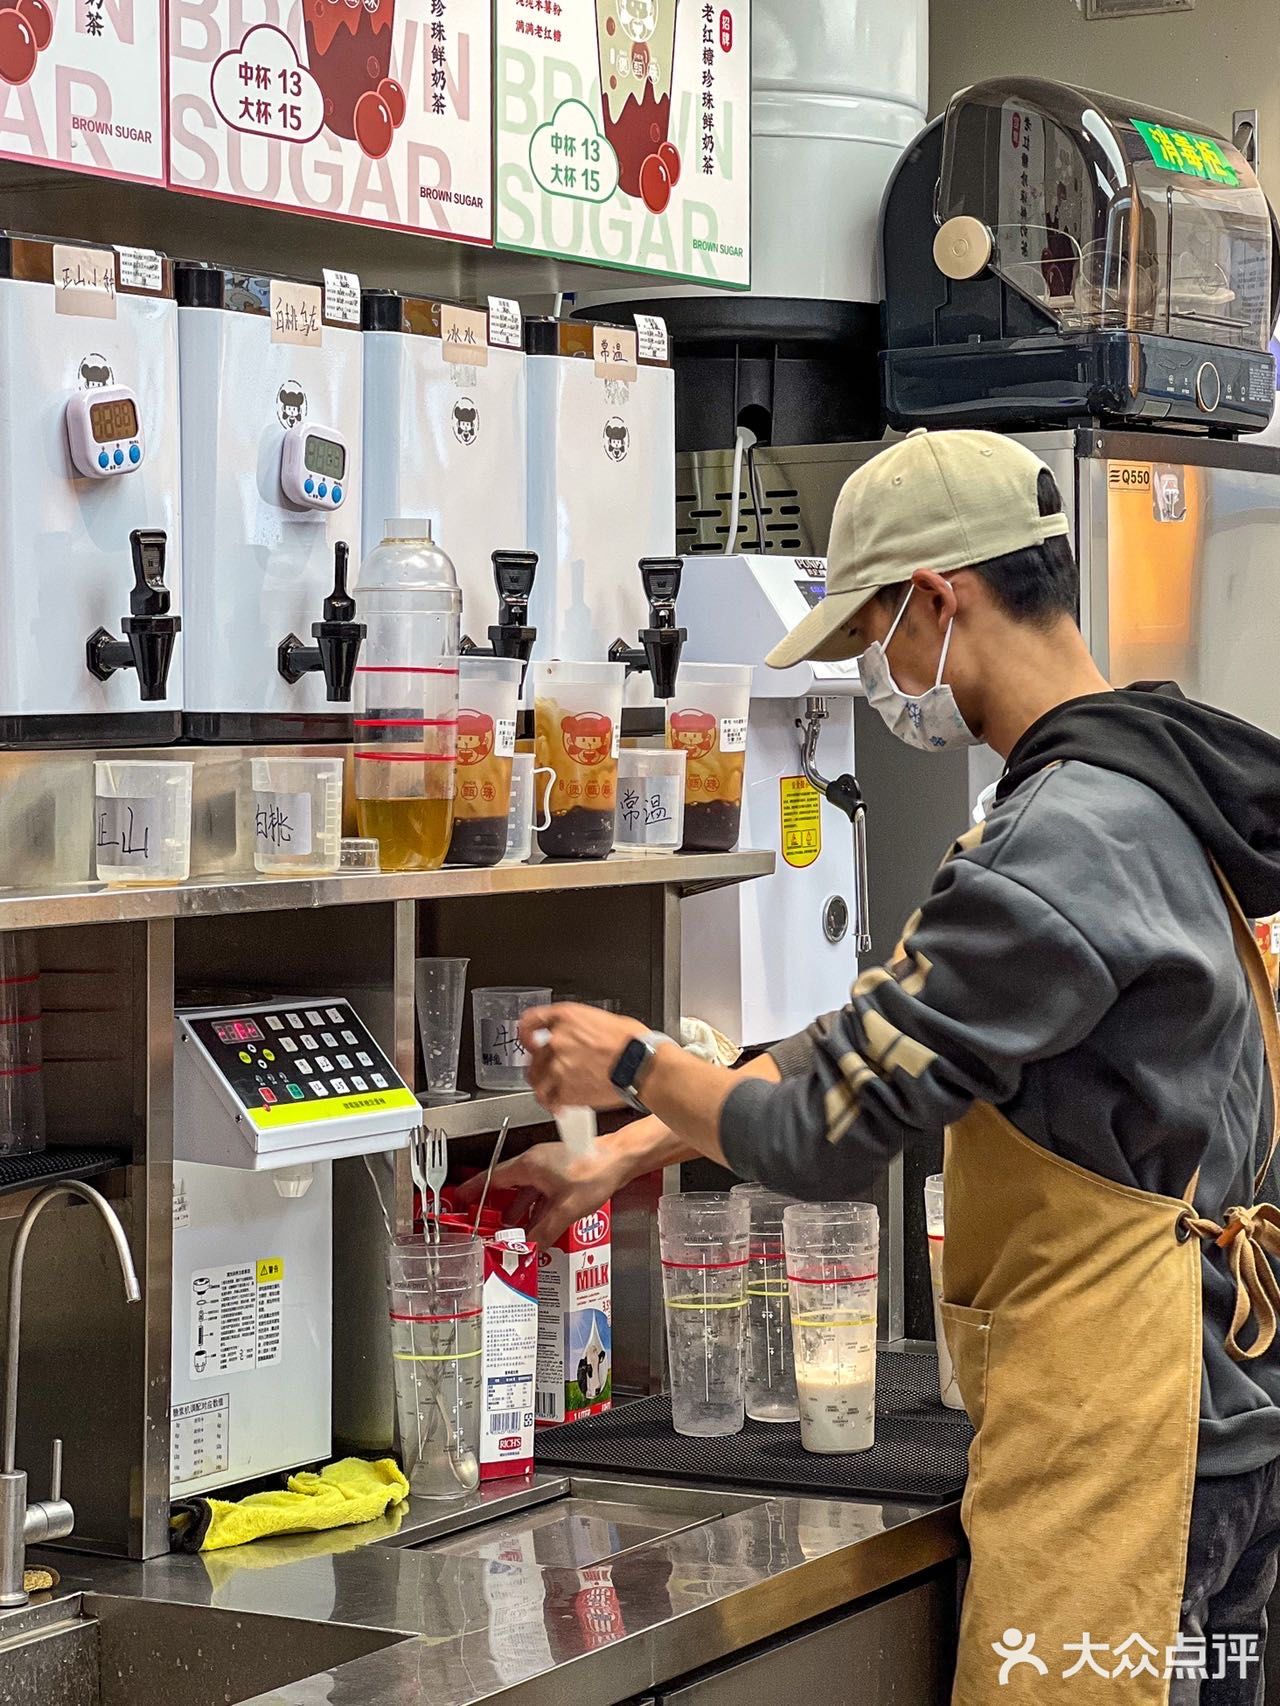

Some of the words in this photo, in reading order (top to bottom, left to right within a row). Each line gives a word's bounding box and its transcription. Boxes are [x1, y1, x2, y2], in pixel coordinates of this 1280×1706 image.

[721, 16, 731, 46] 招牌
[238, 61, 271, 90] 中杯
[278, 68, 302, 97] 13
[701, 3, 715, 176] 老红糖珍珠鲜奶茶
[238, 96, 272, 125] 大杯
[278, 103, 302, 131] 15
[72, 117, 113, 136] BROWN
[115, 125, 152, 144] SUGAR
[550, 132, 577, 158] 中杯
[581, 137, 601, 163] 13
[1148, 127, 1228, 177] 消毒柜
[550, 163, 577, 188] 大杯
[581, 168, 600, 193] 15
[420, 186, 452, 203] BROWN
[453, 192, 483, 209] SUGAR
[692, 239, 719, 254] BROWN
[719, 244, 744, 258] SUGAR
[447, 324, 477, 345] 冰水
[600, 339, 629, 363] 常温
[1121, 469, 1150, 485] Q550
[619, 788, 673, 832] 常温
[575, 1263, 609, 1294] MILK
